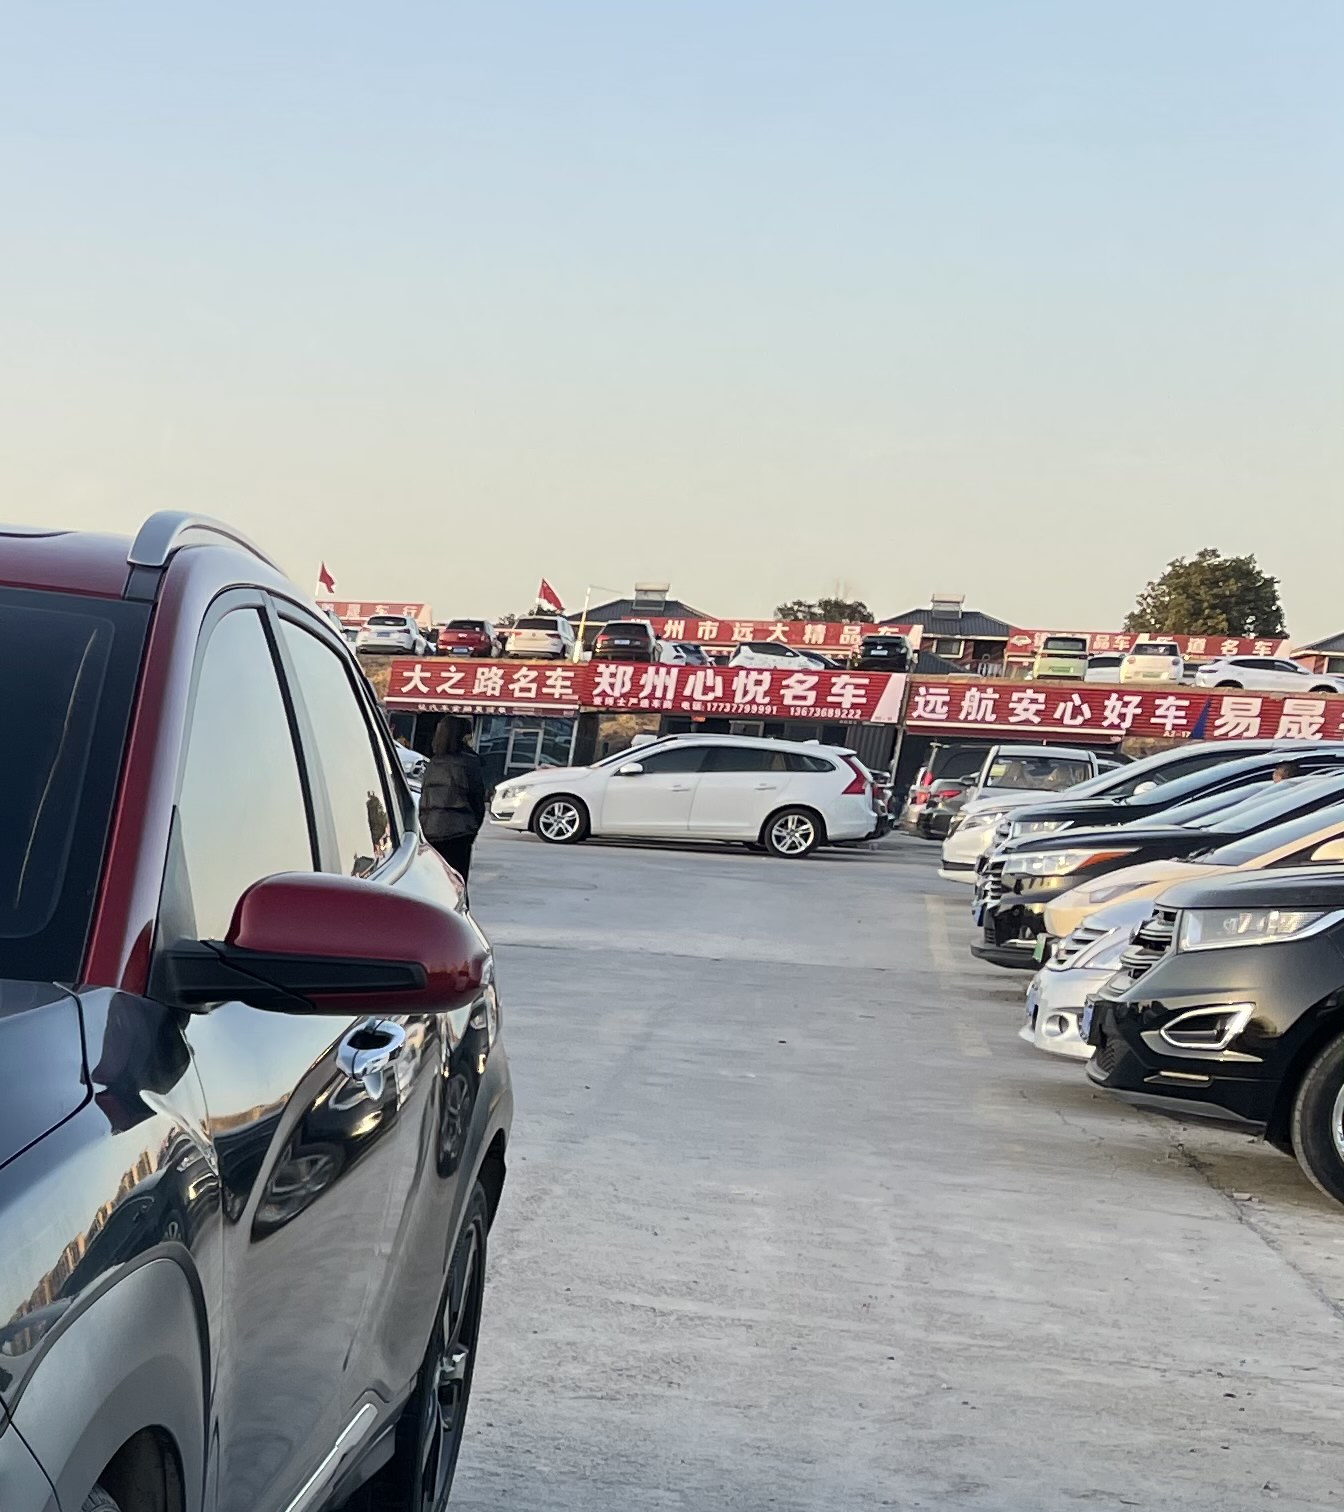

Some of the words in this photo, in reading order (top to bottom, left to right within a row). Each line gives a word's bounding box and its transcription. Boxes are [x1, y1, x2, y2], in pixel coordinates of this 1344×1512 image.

[631, 618, 900, 645] 州市远大精品
[1157, 637, 1273, 656] 道名车
[400, 664, 575, 698] 大之路名车
[592, 663, 871, 709] 郑州心悦名车
[911, 686, 1191, 731] 远航安心好车
[1213, 696, 1344, 741] 易晟
